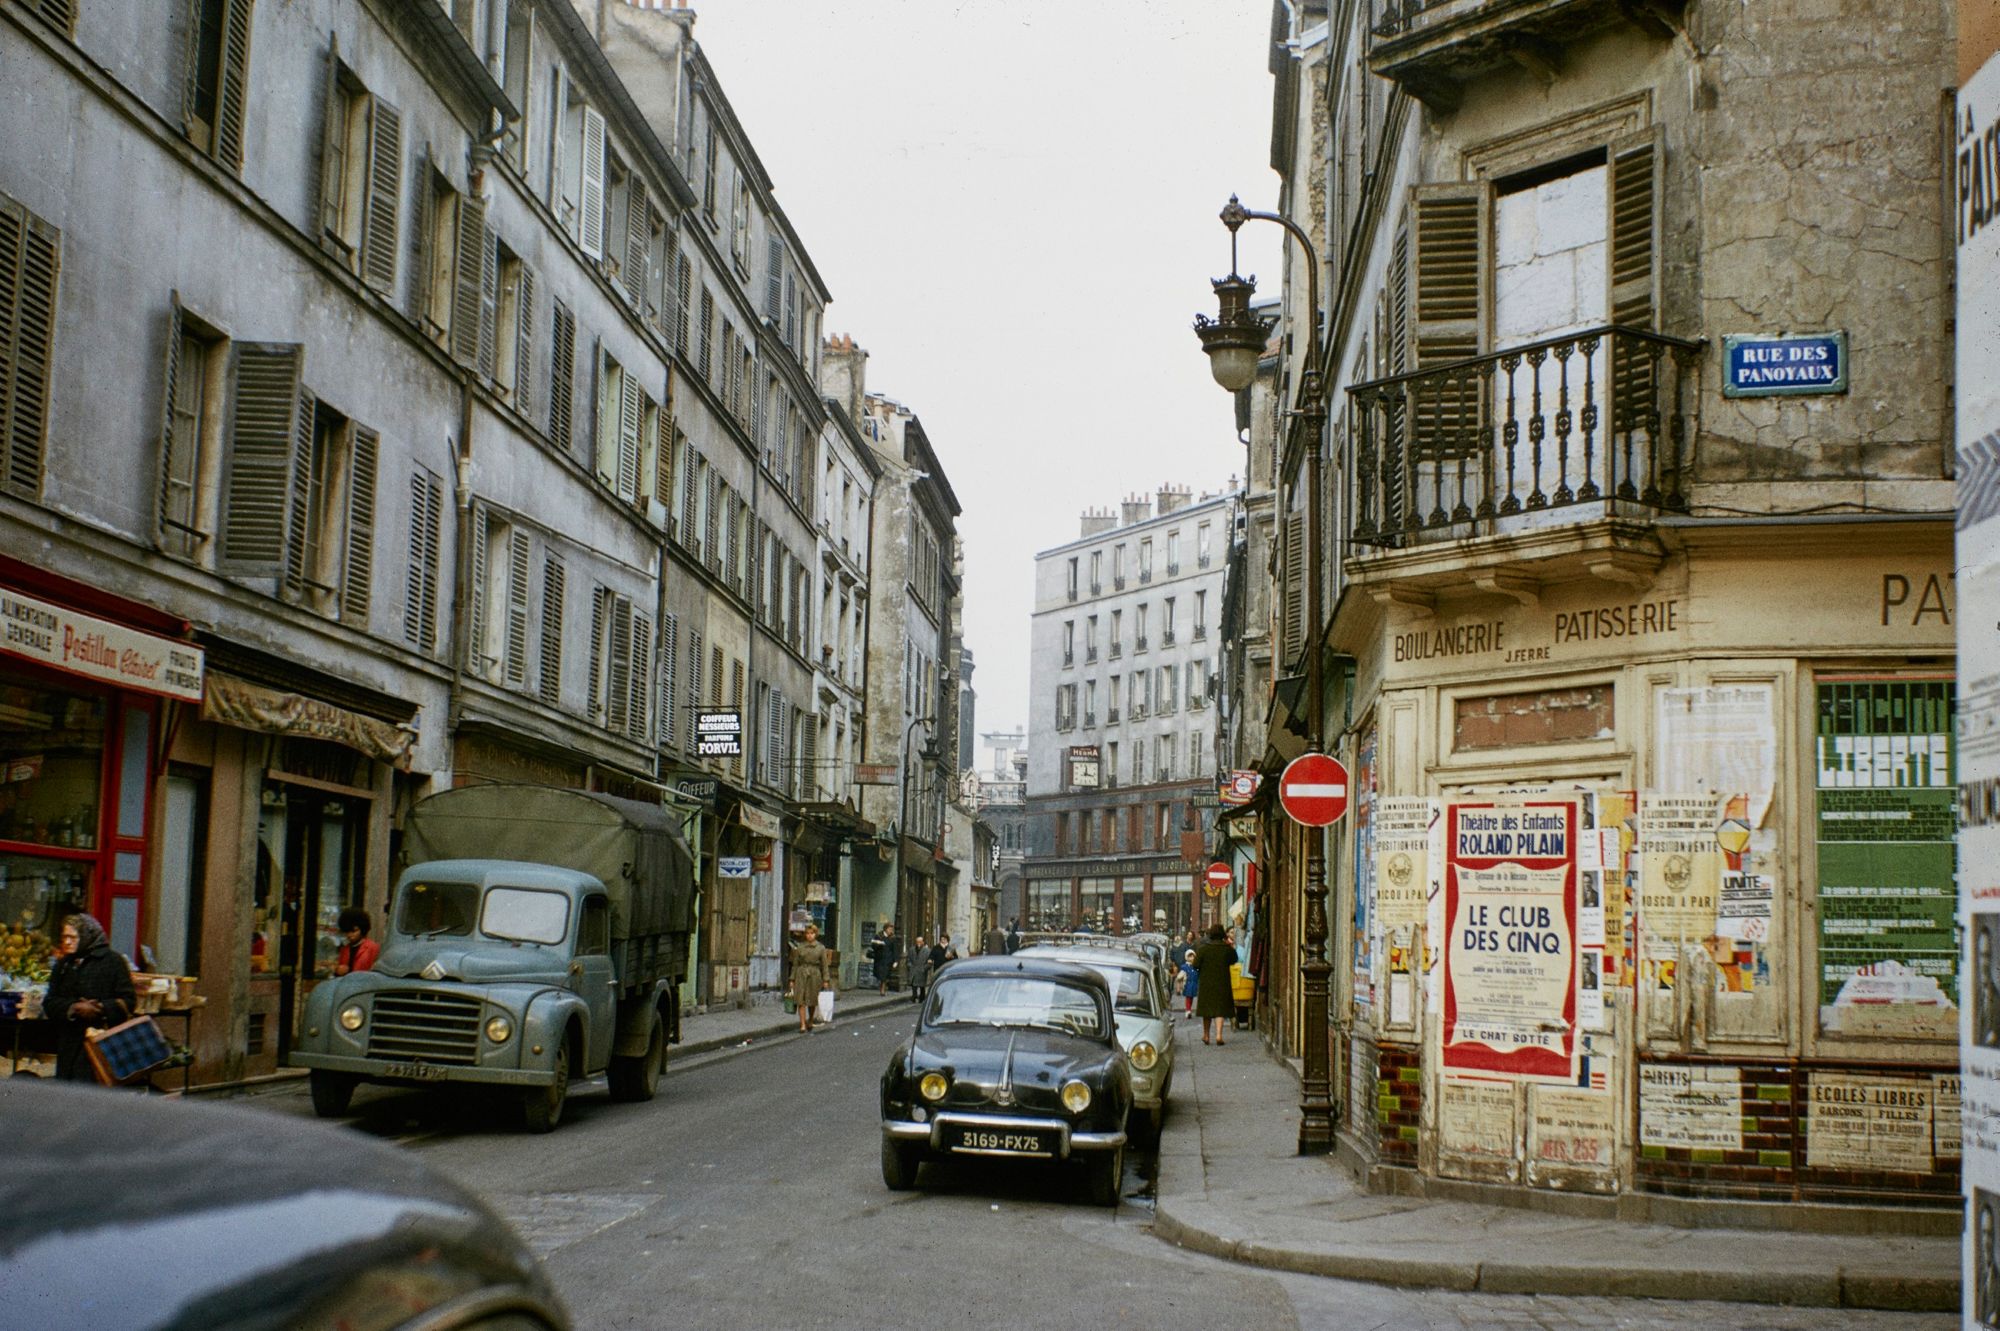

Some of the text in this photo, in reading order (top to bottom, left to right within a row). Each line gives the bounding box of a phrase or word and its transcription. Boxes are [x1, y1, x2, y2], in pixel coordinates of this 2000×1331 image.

[1743, 345, 1828, 363] RUE DES
[1738, 365, 1834, 384] PANOYAUX
[1395, 600, 1677, 663] BOULANGERIE PATISSERIE
[63, 623, 118, 670] Postillon
[698, 722, 740, 731] MESSIEURS
[700, 714, 738, 723] COIFFEUR
[698, 742, 740, 754] FORVIL
[1460, 812, 1564, 831] Théâtre des Enfants
[1460, 833, 1564, 856] ROLAND PILAIN
[1469, 905, 1551, 928] LE CLUB
[1464, 930, 1560, 954] DES CINQ
[1463, 1029, 1475, 1038] LE
[1480, 1030, 1508, 1041] CHAT
[1875, 1090, 1925, 1107] LIBRES
[1879, 1110, 1919, 1121] FILLES
